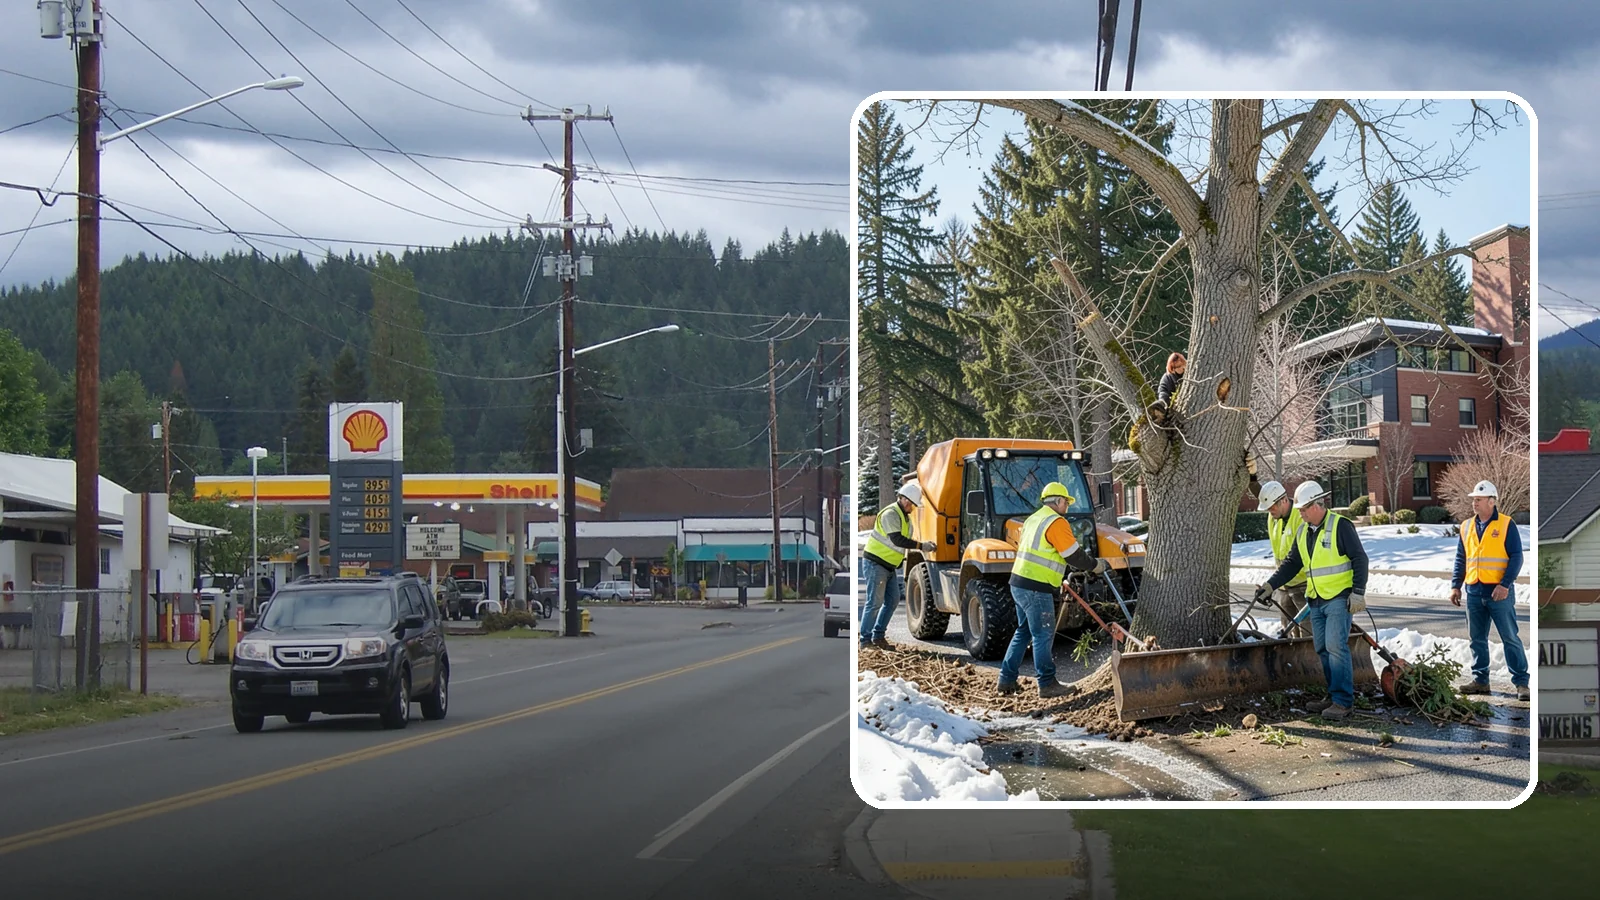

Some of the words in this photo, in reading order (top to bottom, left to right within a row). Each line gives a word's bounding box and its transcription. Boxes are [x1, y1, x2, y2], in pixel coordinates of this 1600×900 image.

[366, 480, 383, 490] 395
[490, 485, 547, 498] Shell
[366, 494, 383, 504] 405
[366, 508, 383, 518] 415
[366, 522, 383, 533] 429
